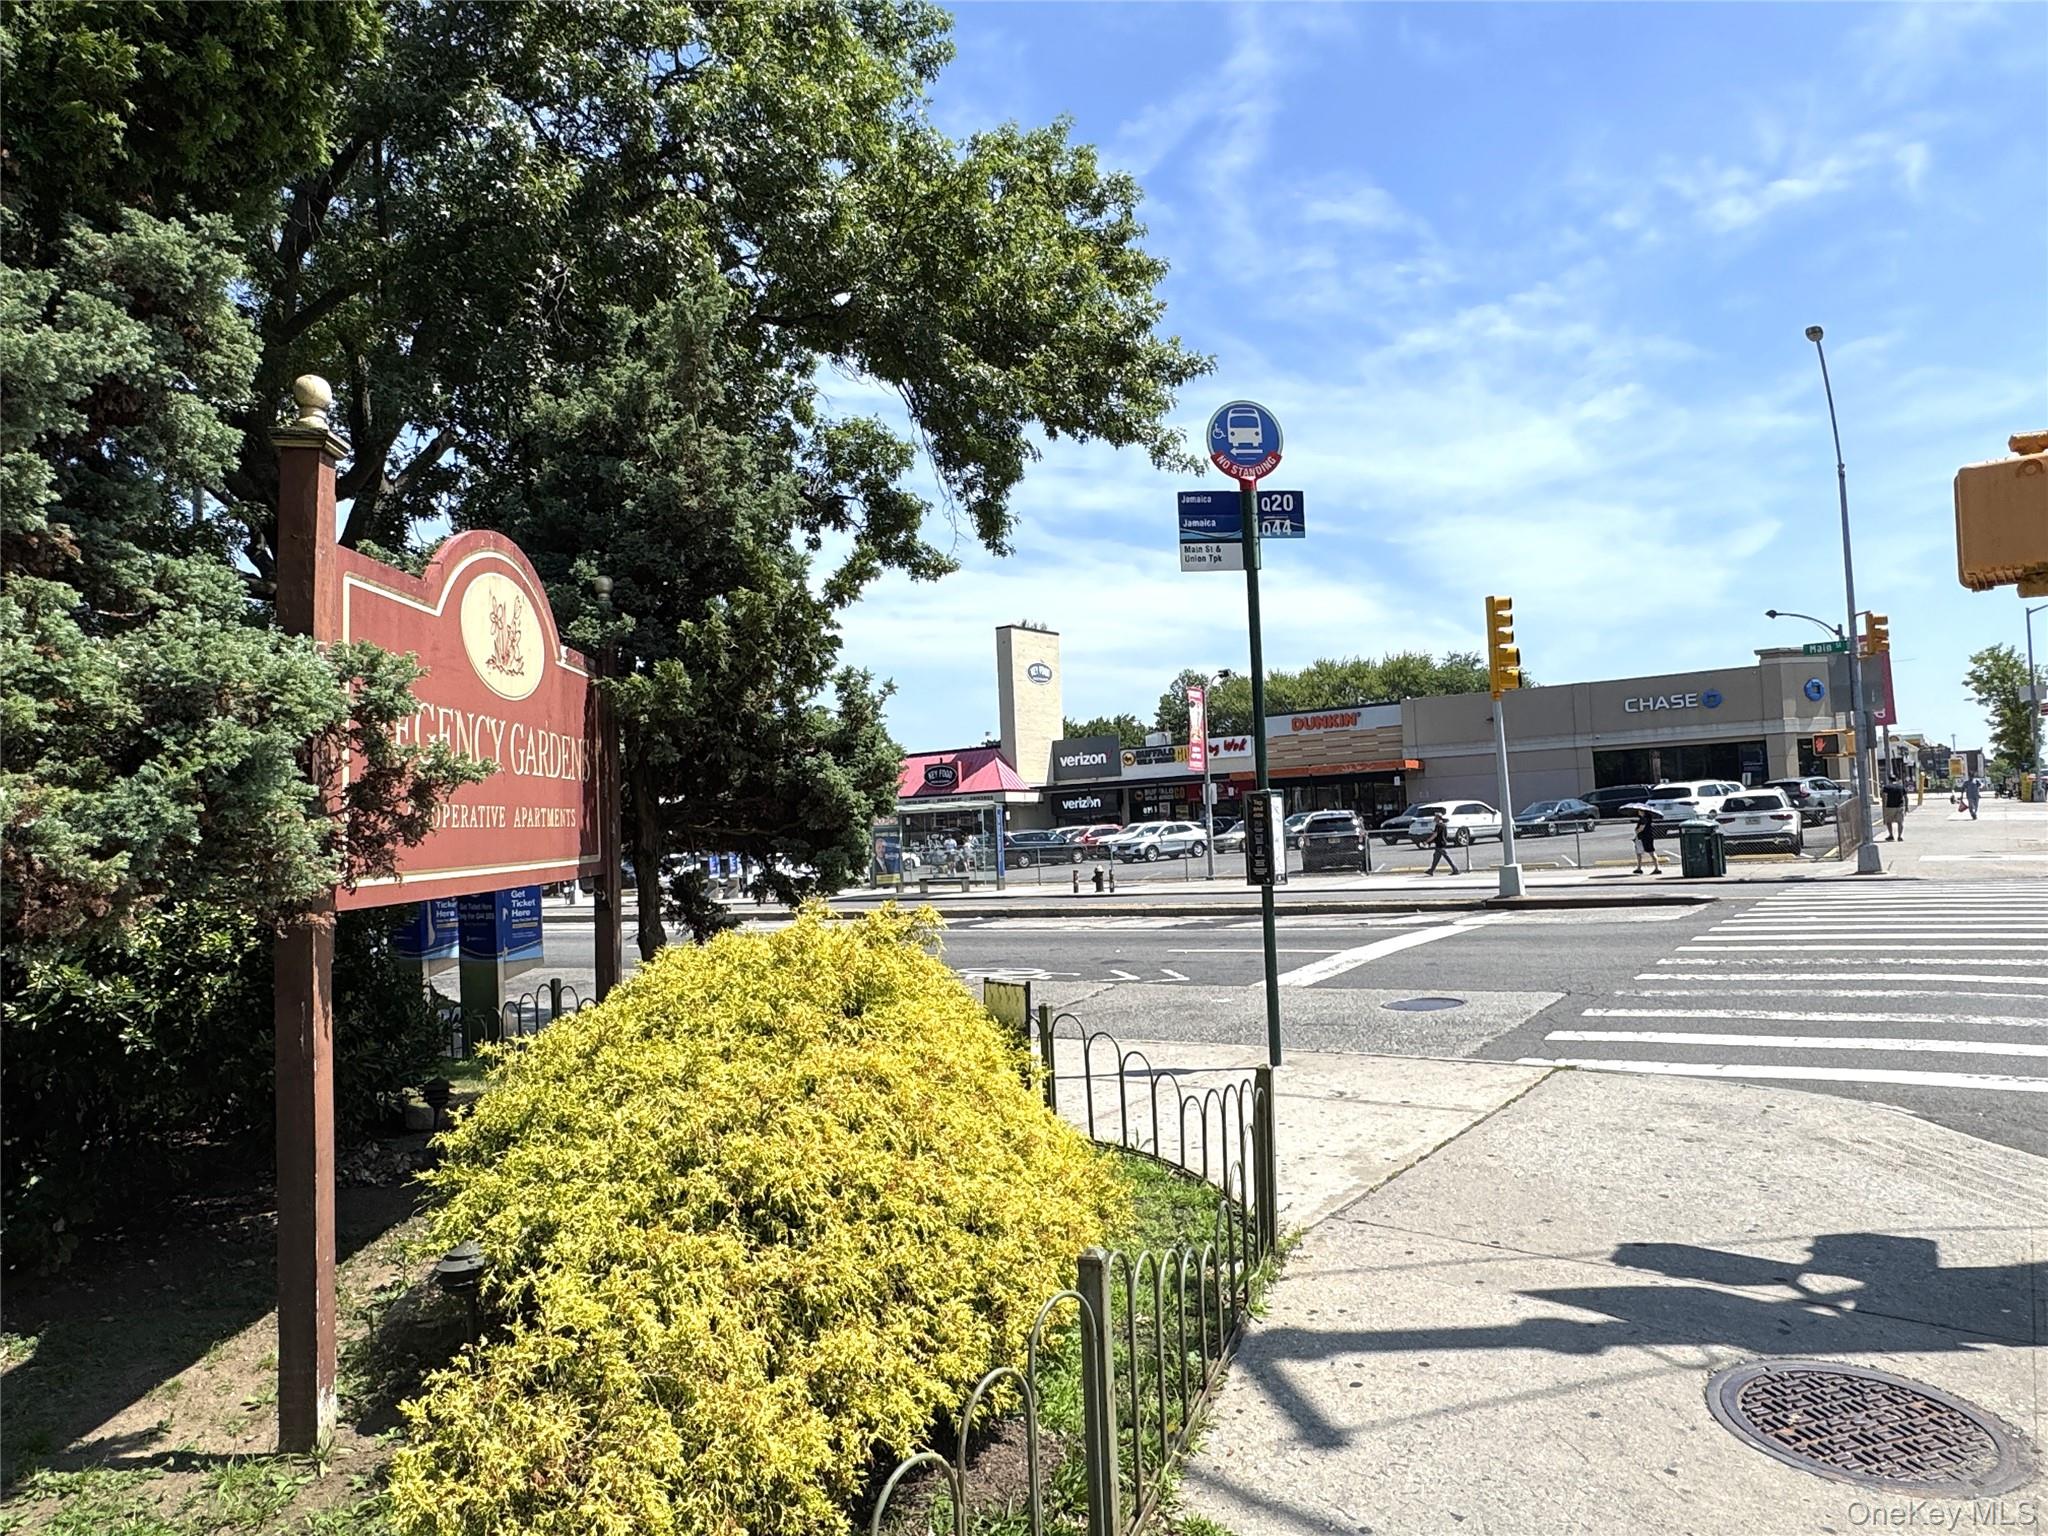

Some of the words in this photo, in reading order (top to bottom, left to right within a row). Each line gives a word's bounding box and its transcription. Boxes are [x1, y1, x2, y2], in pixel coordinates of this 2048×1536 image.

[1216, 455, 1229, 470] NO
[1231, 456, 1277, 477] STANDING
[1181, 495, 1212, 504] Jamaica
[1261, 494, 1294, 512] Q20
[1183, 518, 1216, 528] Jamaica
[1262, 519, 1292, 536] Q44
[1184, 545, 1203, 553] Main
[1205, 545, 1214, 553] St
[1184, 554, 1206, 563] Union
[1209, 554, 1222, 564] Tpk
[1809, 643, 1832, 654] Main
[1624, 692, 1698, 713] CHASE
[1291, 711, 1361, 732] DUNKIN'
[392, 702, 506, 773] EGENCY
[510, 721, 591, 783] GARDENS
[1136, 747, 1175, 758] BUFFALO
[1060, 752, 1107, 767] verizon
[1144, 786, 1174, 796] BUFALO
[431, 803, 506, 828] OPERATIVE
[514, 805, 576, 828] APARTMENTS
[511, 889, 526, 898] Get
[512, 899, 536, 908] Ticket
[436, 910, 455, 918] Here
[511, 909, 531, 917] Here
